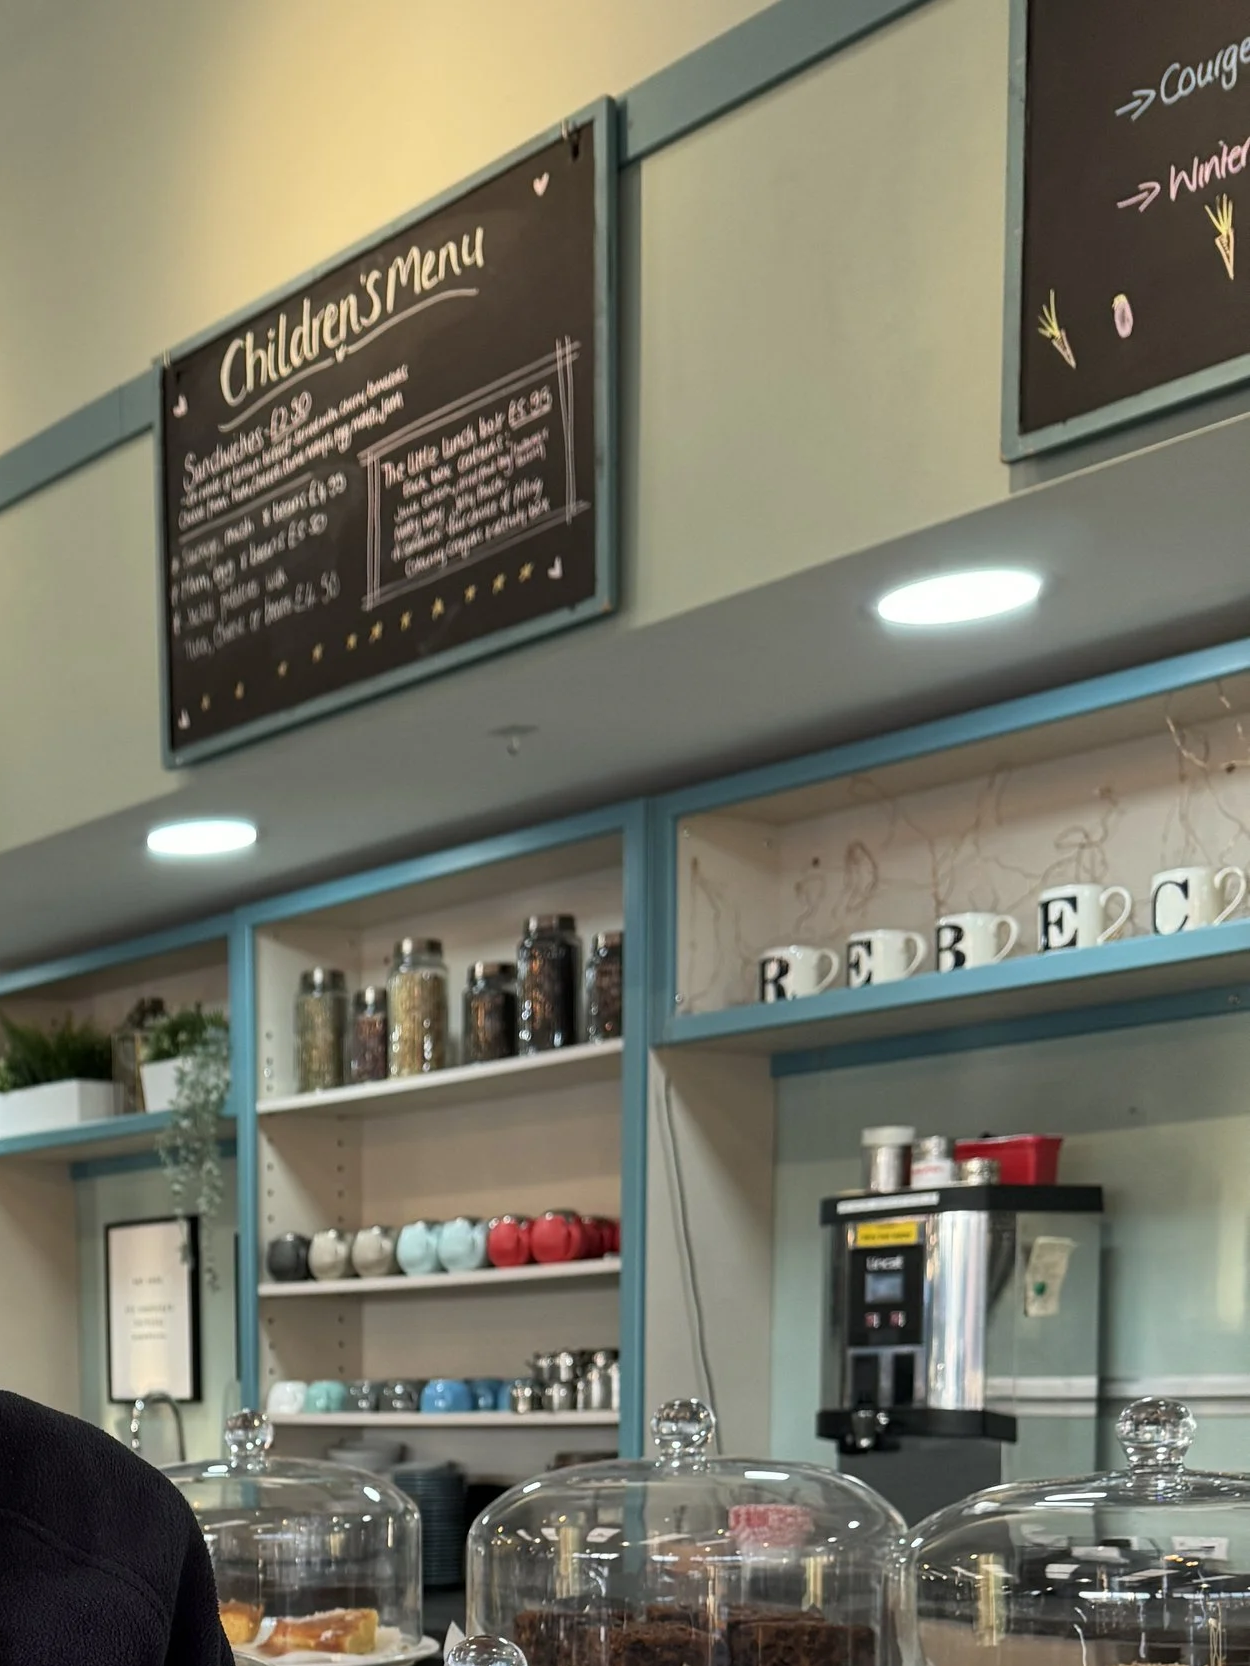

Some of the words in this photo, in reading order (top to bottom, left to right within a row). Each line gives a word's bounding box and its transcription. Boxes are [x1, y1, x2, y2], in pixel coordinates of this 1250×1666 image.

[220, 270, 382, 407] Children's
[386, 227, 484, 314] Menu
[1038, 896, 1078, 953] E
[1153, 878, 1190, 935] C
